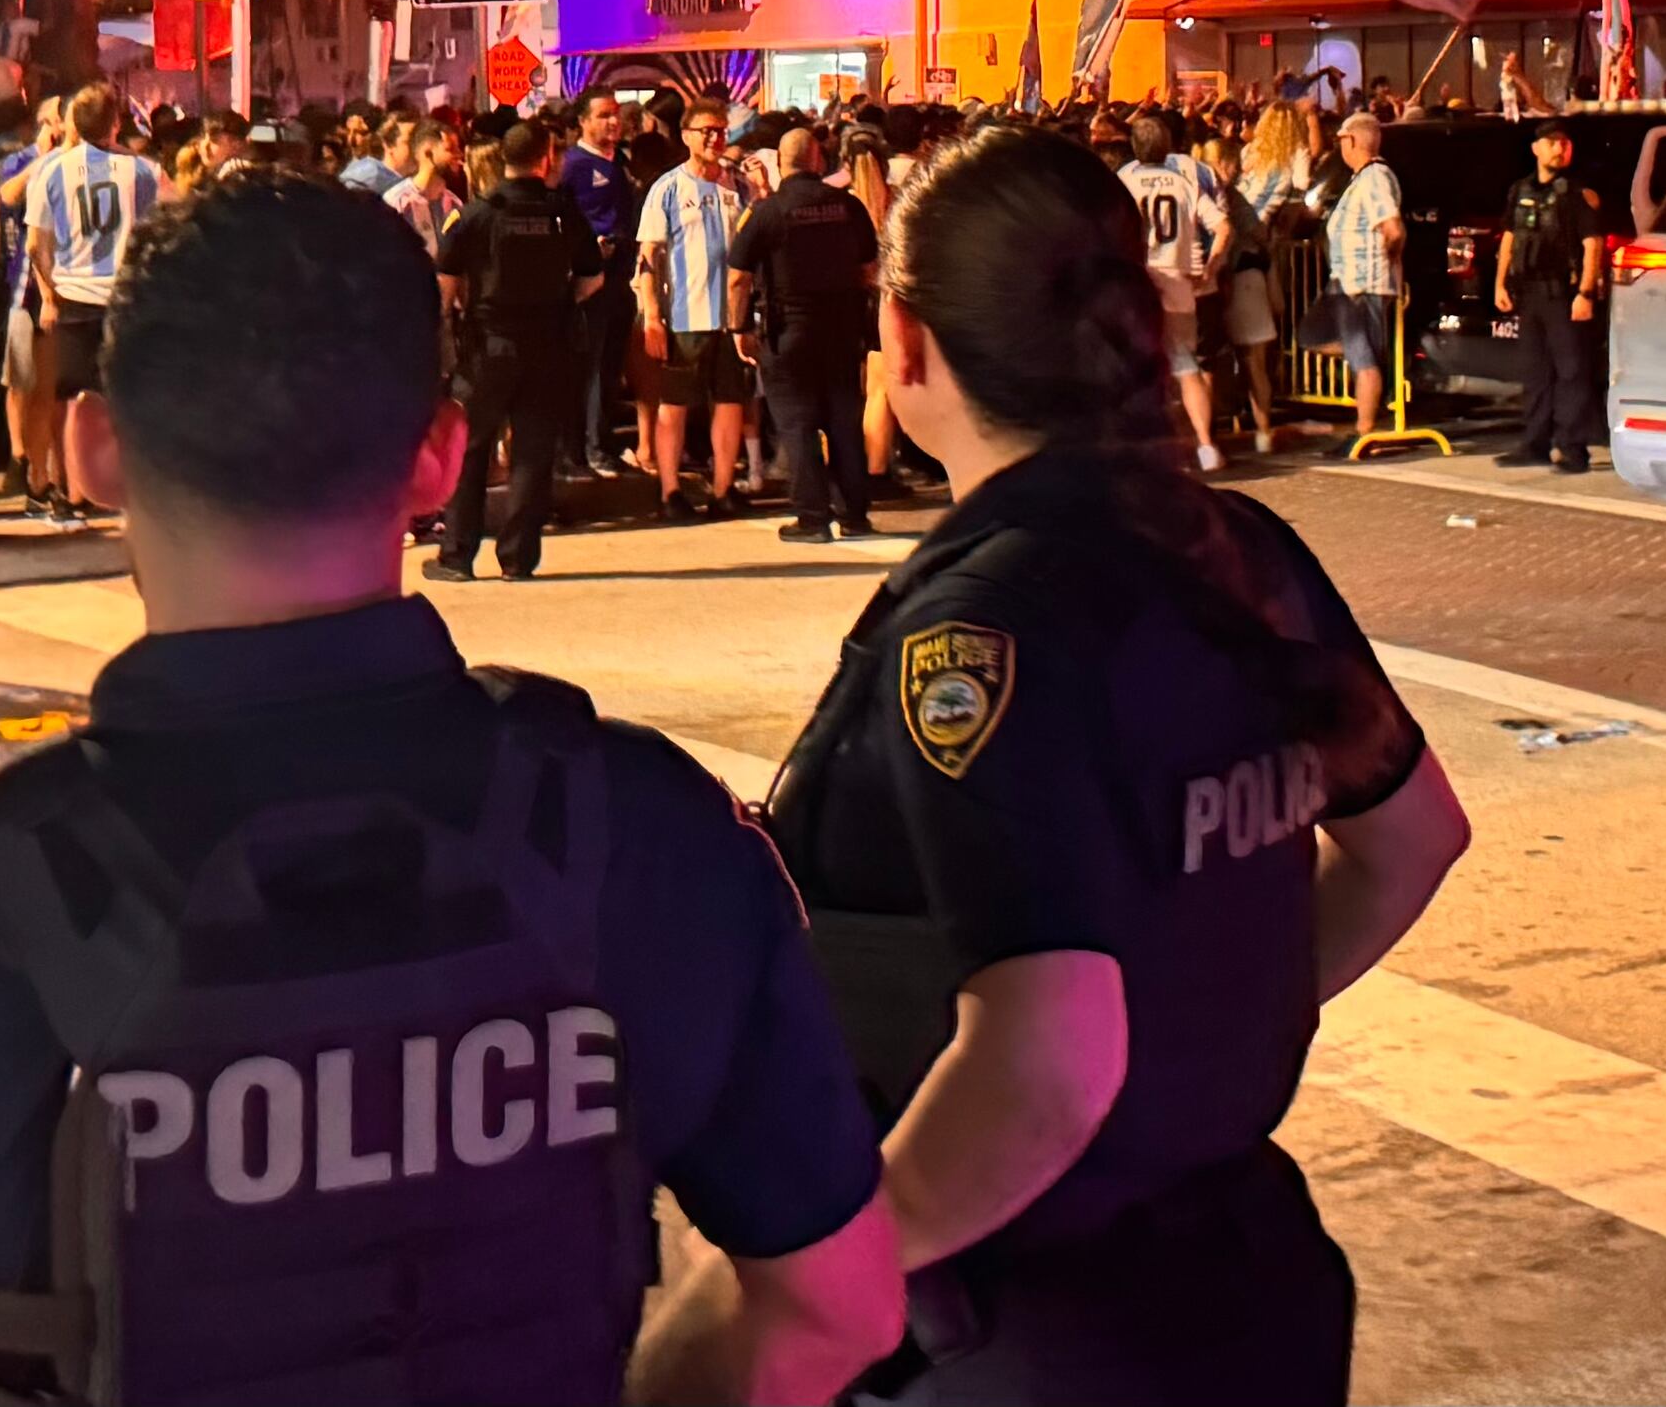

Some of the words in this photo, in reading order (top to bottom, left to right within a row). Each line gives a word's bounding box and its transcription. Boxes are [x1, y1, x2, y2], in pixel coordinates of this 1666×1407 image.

[493, 50, 525, 62] ROAD
[494, 66, 525, 76] WORK
[492, 81, 529, 91] AHEAD
[76, 181, 122, 236] 10
[97, 1005, 616, 1212] POLICE
